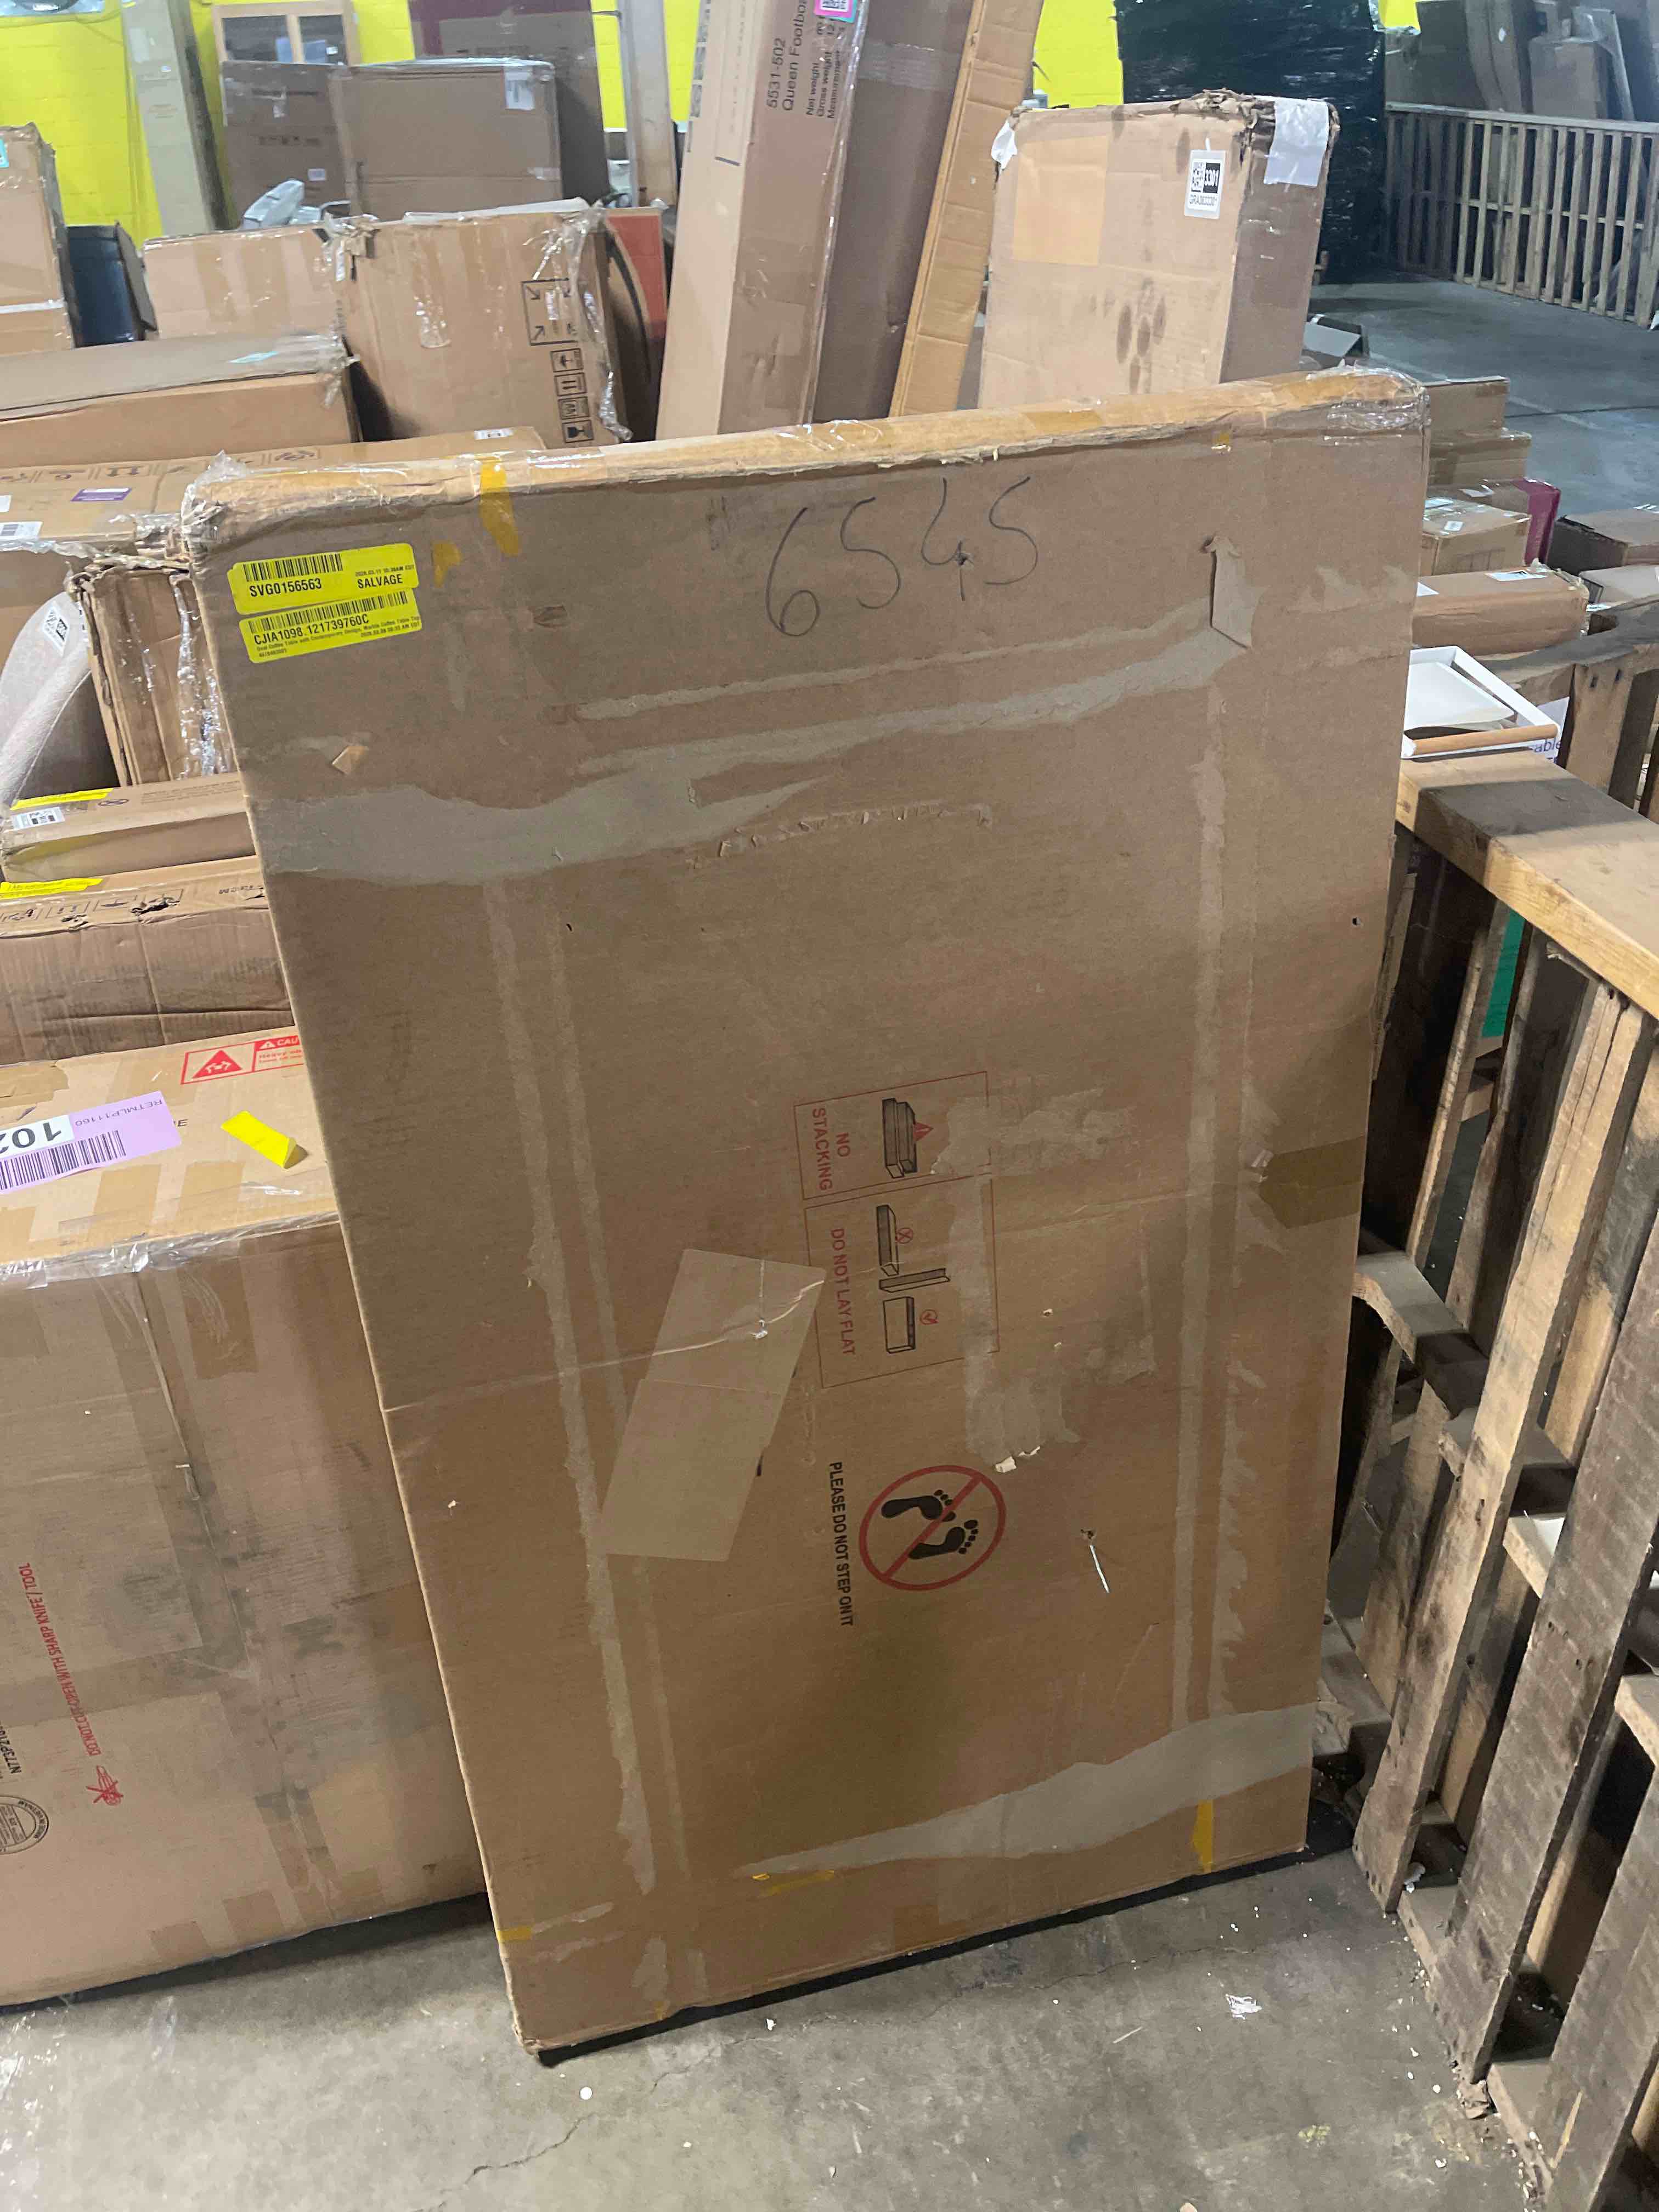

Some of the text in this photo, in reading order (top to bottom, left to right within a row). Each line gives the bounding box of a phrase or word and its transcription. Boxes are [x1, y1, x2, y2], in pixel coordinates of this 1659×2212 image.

[766, 37, 786, 109] 5531-502
[782, 61, 799, 111] Queen
[806, 98, 816, 115] Net
[1204, 169, 1220, 187] 3301
[249, 578, 322, 597] SVG0156563
[358, 574, 403, 589] SALVAGE
[75, 1098, 163, 1126] RETMLP11160
[812, 1108, 833, 1192] STACKING
[836, 1132, 851, 1158] NO
[831, 1228, 856, 1356] DO NOT LAY FLAT
[829, 1461, 845, 1513] PLEASE
[832, 1515, 847, 1534] DO
[834, 1534, 849, 1560] NOT
[19, 1562, 37, 1590] TOOL
[836, 1562, 850, 1594] STEP
[30, 1597, 50, 1624] KNIFE
[40, 1626, 62, 1656] SHARP
[51, 1656, 71, 1681] WITH
